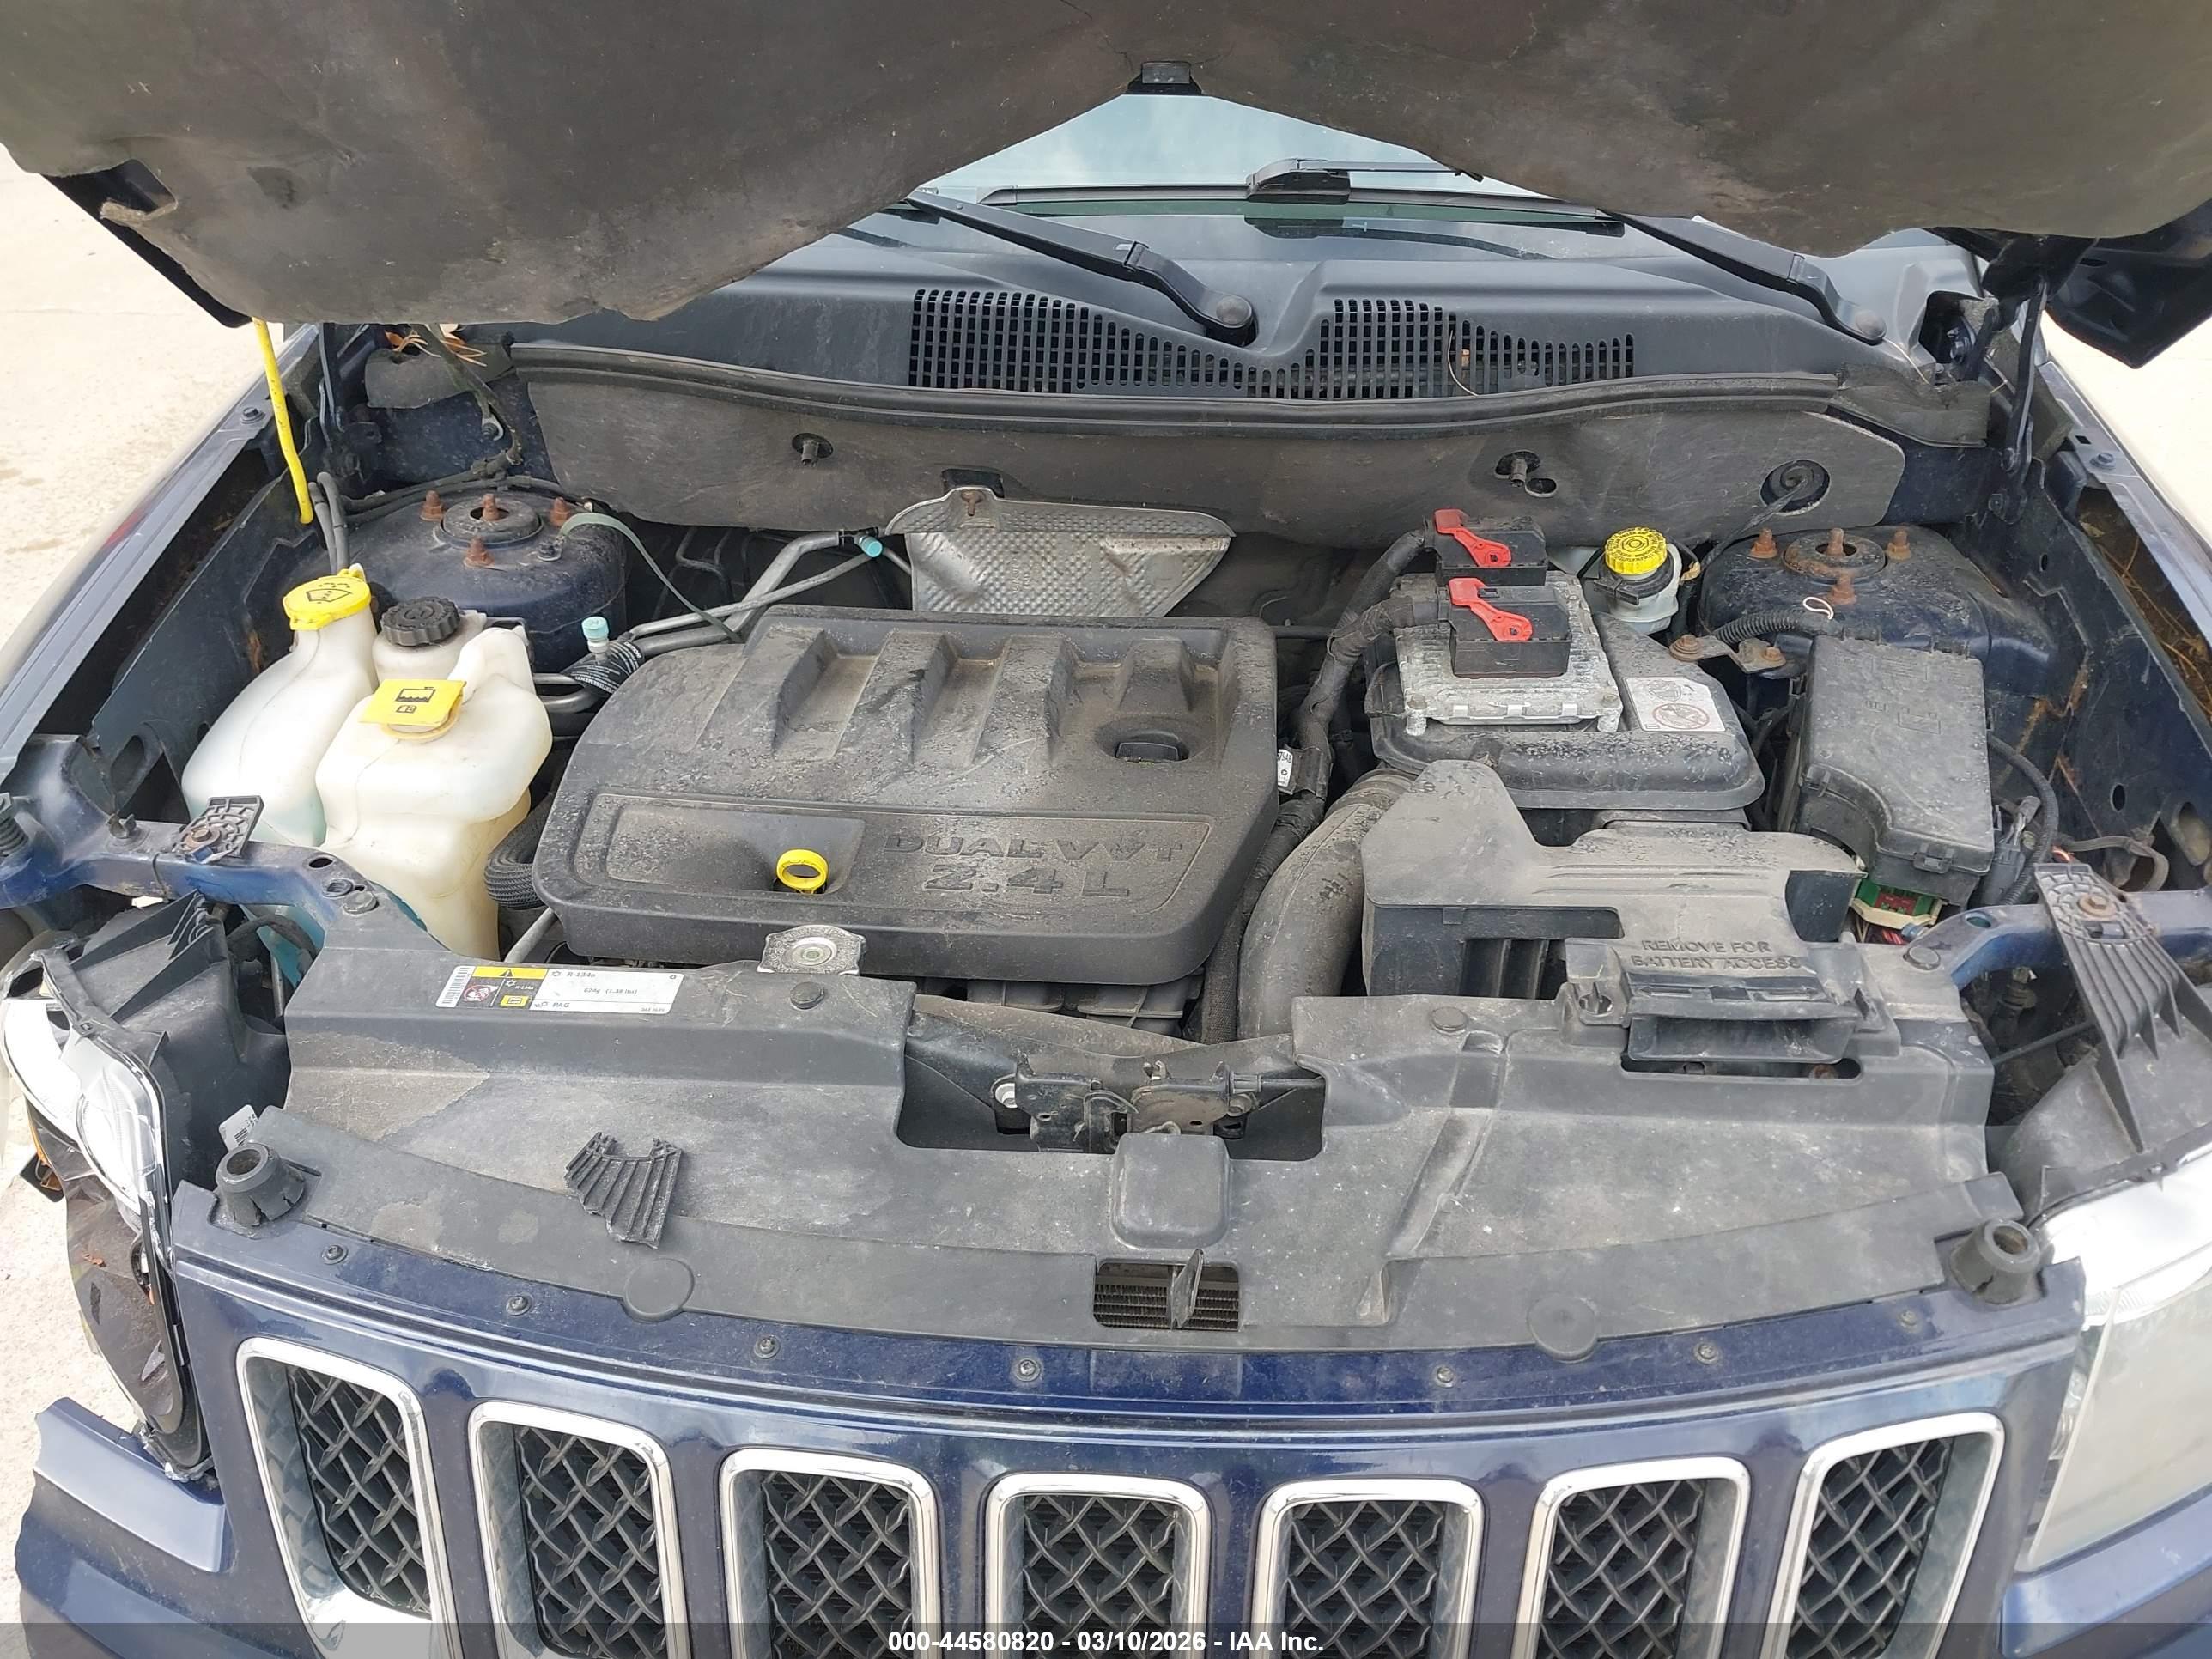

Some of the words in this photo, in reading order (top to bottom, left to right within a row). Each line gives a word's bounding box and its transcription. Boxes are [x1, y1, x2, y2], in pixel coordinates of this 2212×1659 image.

[883, 836, 1044, 860] DUAL
[1053, 839, 1183, 863] VVT
[921, 863, 1131, 898] 2.4L
[1641, 939, 1727, 953] REMOVE
[1732, 941, 1773, 953] FOR
[1631, 955, 1715, 969] BATTERY
[1723, 957, 1803, 970] ACCESS
